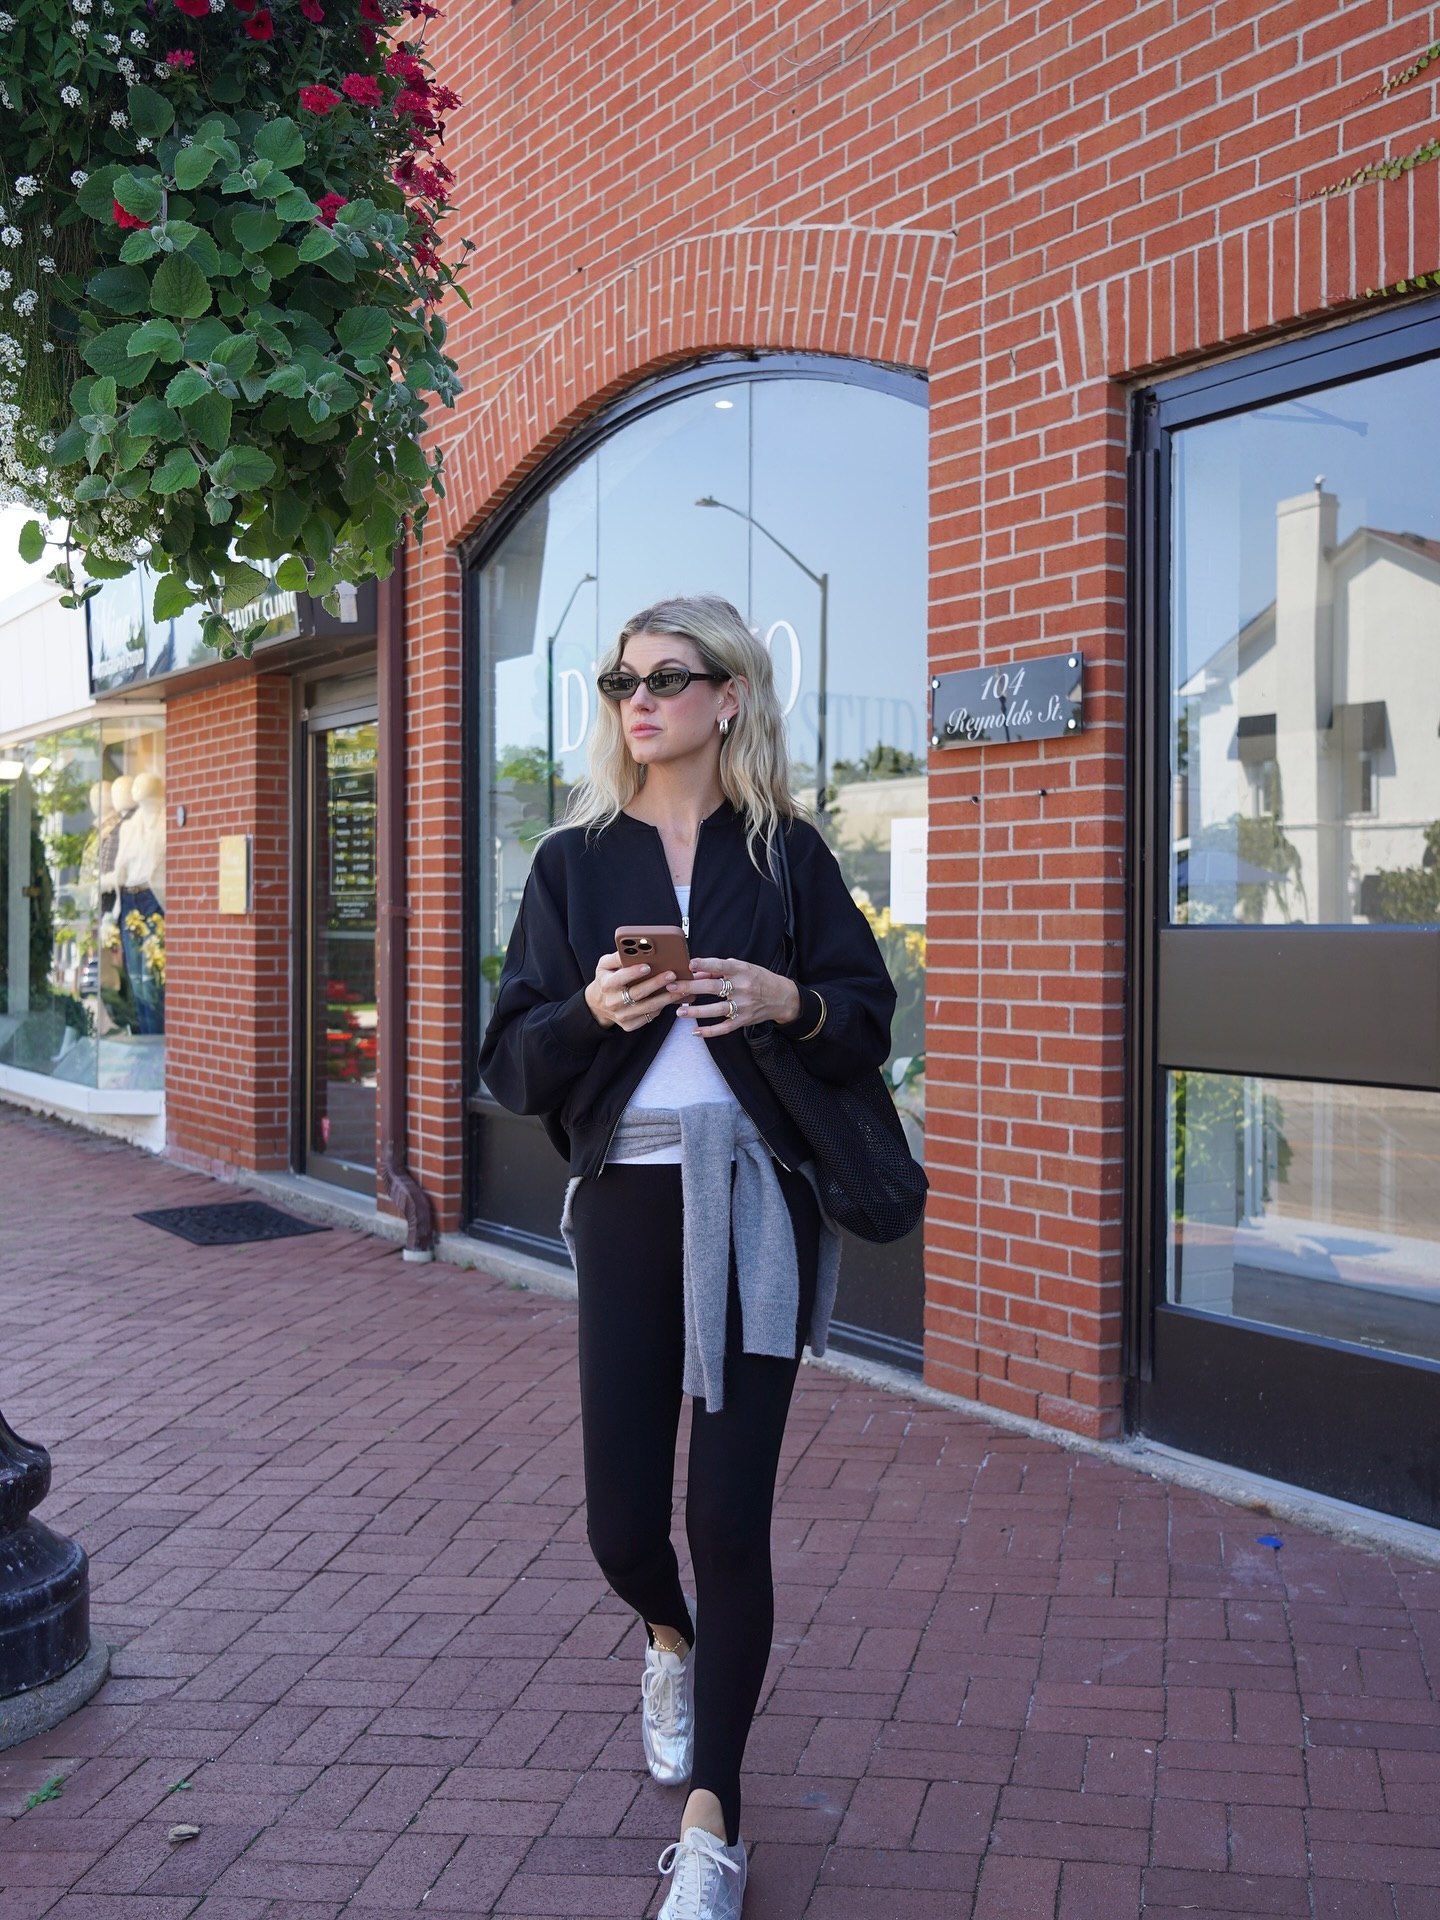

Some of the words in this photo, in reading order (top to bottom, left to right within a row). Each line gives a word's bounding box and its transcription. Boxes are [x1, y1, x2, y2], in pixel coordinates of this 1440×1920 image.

[224, 602, 261, 632] EAUTY
[981, 667, 1026, 701] 104
[946, 699, 1033, 742] Reynolds
[1038, 694, 1063, 724] St.
